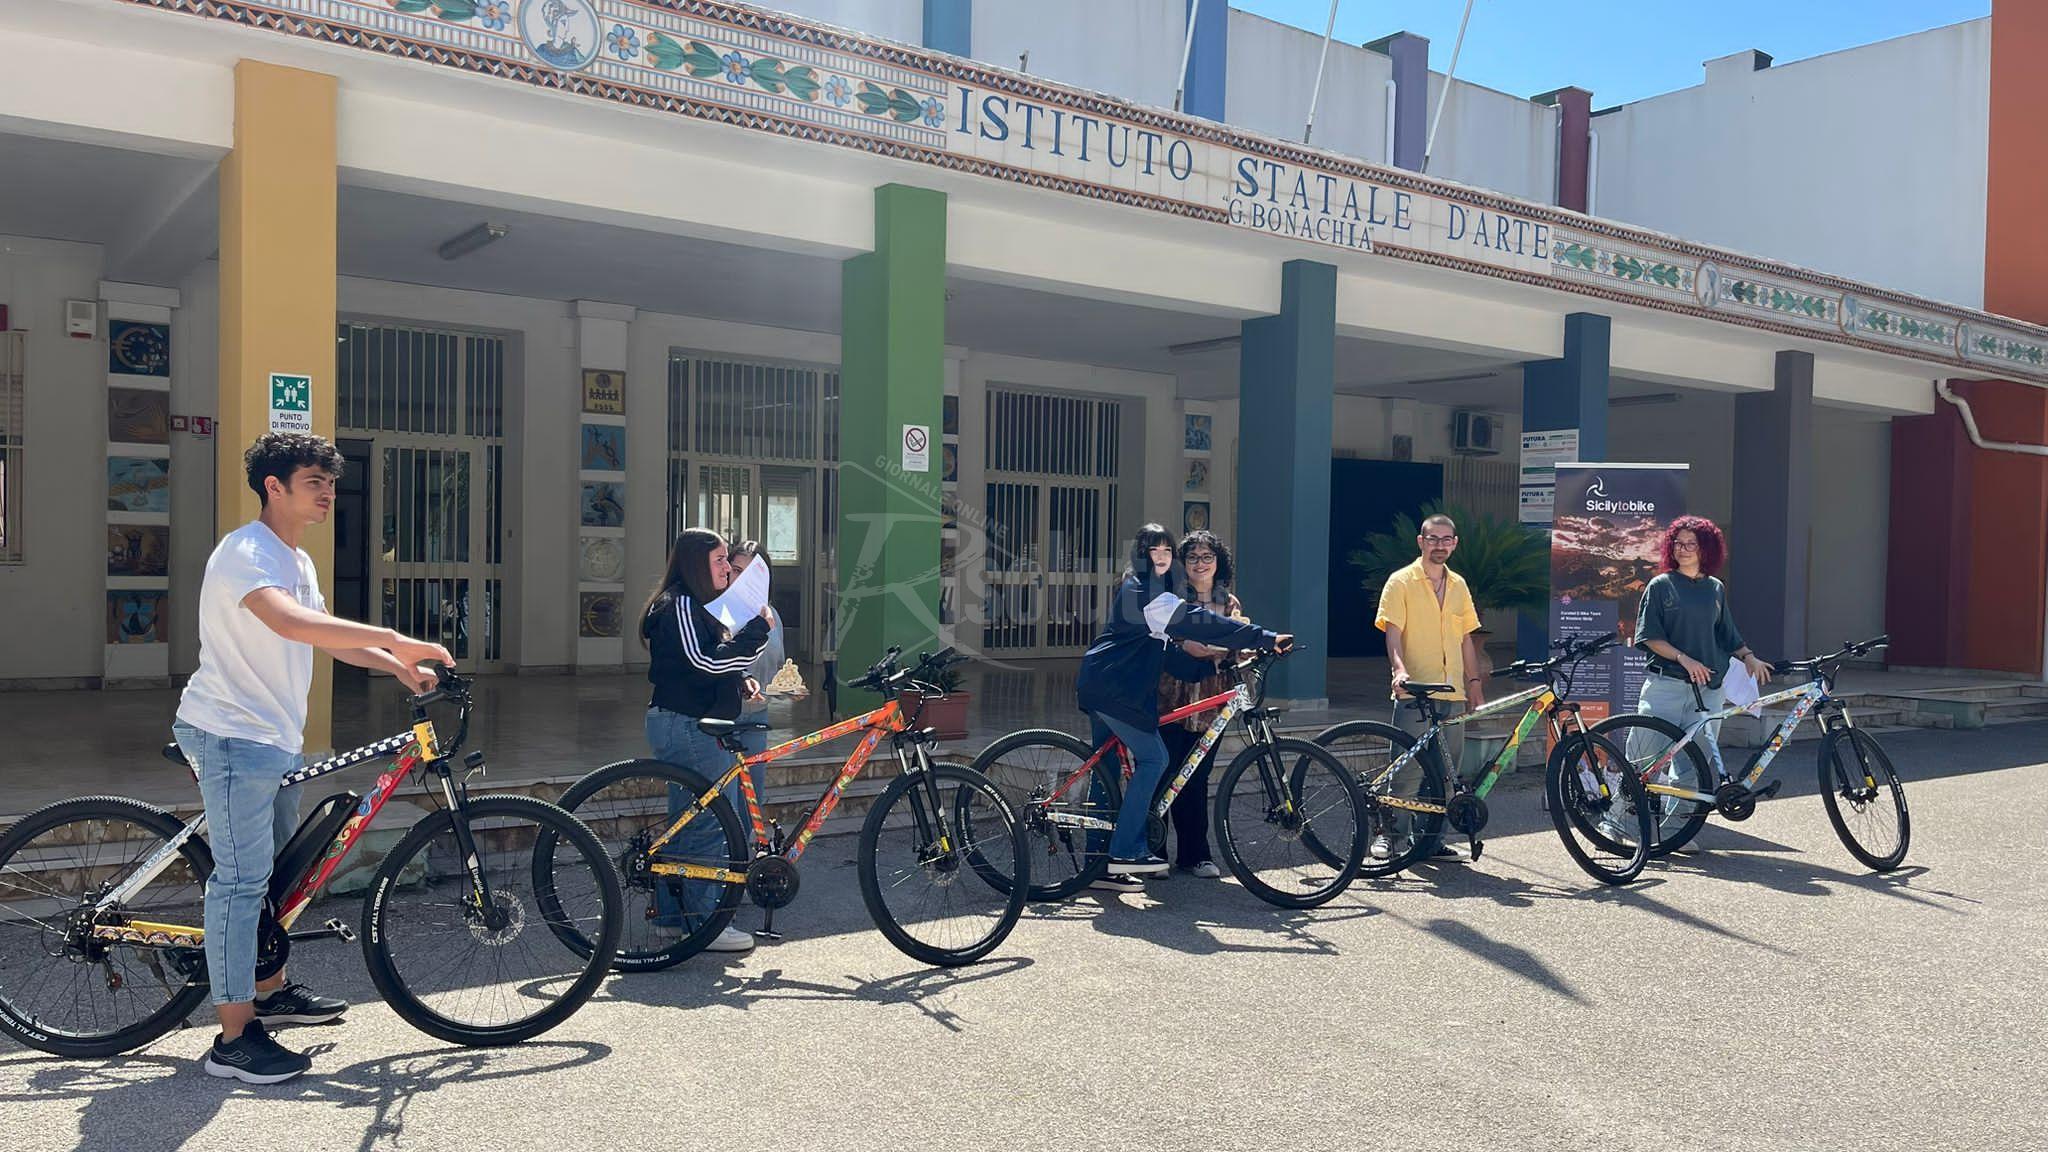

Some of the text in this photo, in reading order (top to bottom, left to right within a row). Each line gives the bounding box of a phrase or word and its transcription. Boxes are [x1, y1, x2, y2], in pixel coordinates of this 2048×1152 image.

[956, 86, 1193, 181] ISTITUTO
[1235, 157, 1412, 231] STATALE
[280, 413, 302, 421] PUNTO
[272, 421, 309, 430] DI RITROVO
[371, 911, 379, 925] ALL
